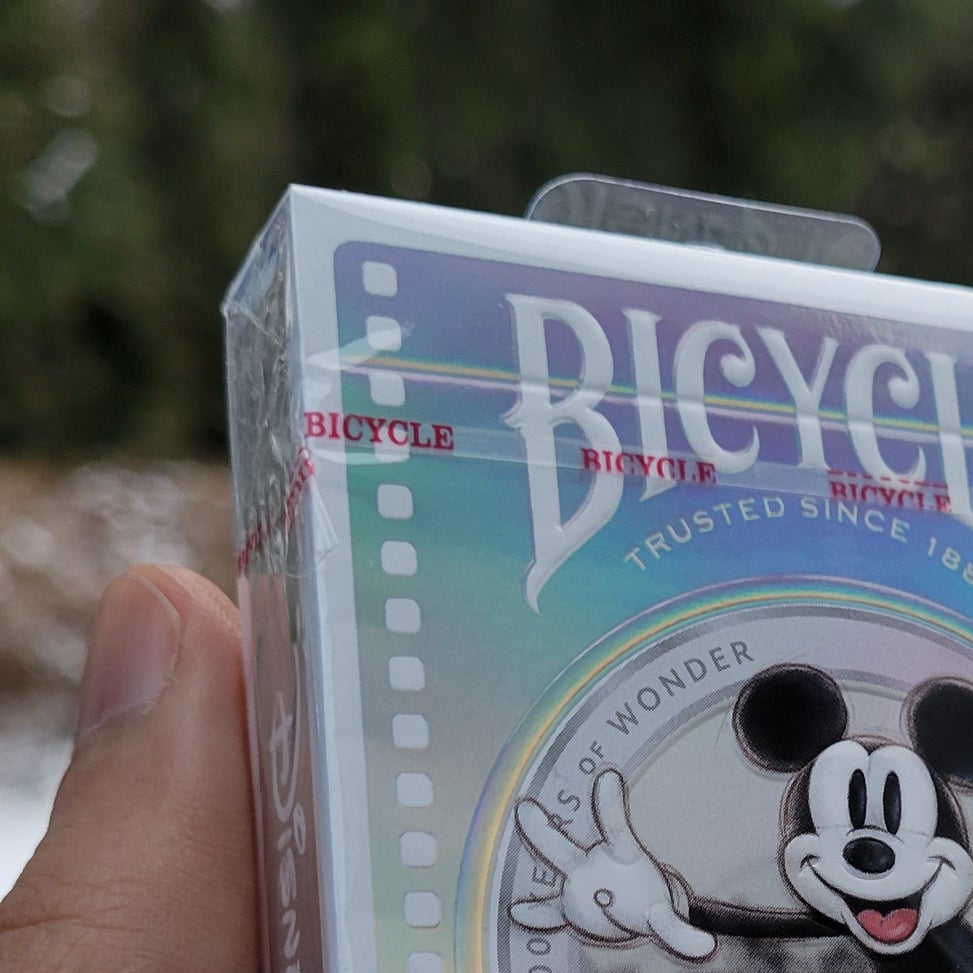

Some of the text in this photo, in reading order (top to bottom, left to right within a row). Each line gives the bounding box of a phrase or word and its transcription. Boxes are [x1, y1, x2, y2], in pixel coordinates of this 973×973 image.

[304, 411, 455, 450] BICYCLE
[579, 447, 717, 485] BICYCLE
[624, 496, 786, 571] TRUSTED
[800, 495, 911, 544] SINCE
[578, 740, 604, 776] OF
[605, 639, 756, 737] WONDER
